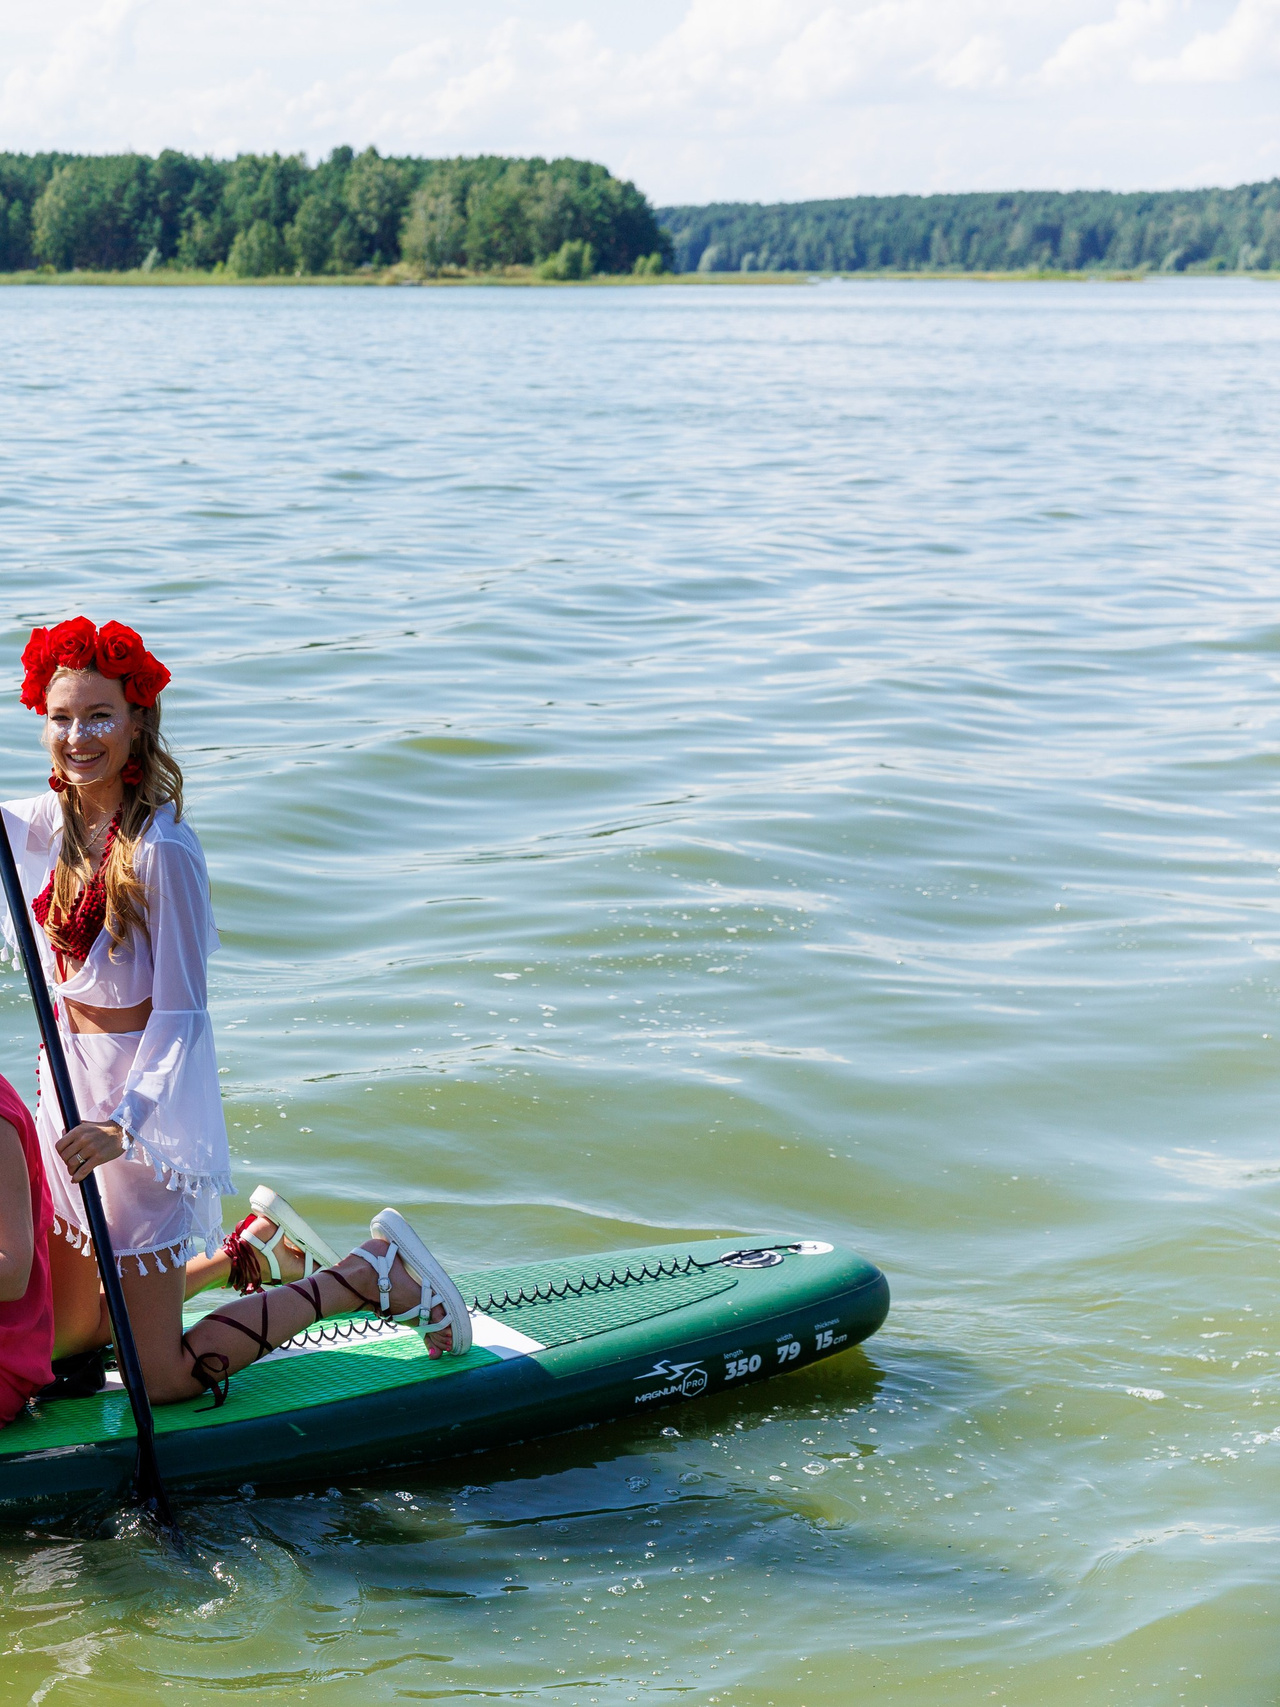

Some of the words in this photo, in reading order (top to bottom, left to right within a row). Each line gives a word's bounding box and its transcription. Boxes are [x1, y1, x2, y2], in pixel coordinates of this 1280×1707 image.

[724, 1354, 762, 1381] 350
[777, 1341, 801, 1364] 79
[634, 1384, 682, 1404] MAGNUM
[686, 1377, 705, 1390] PRO
